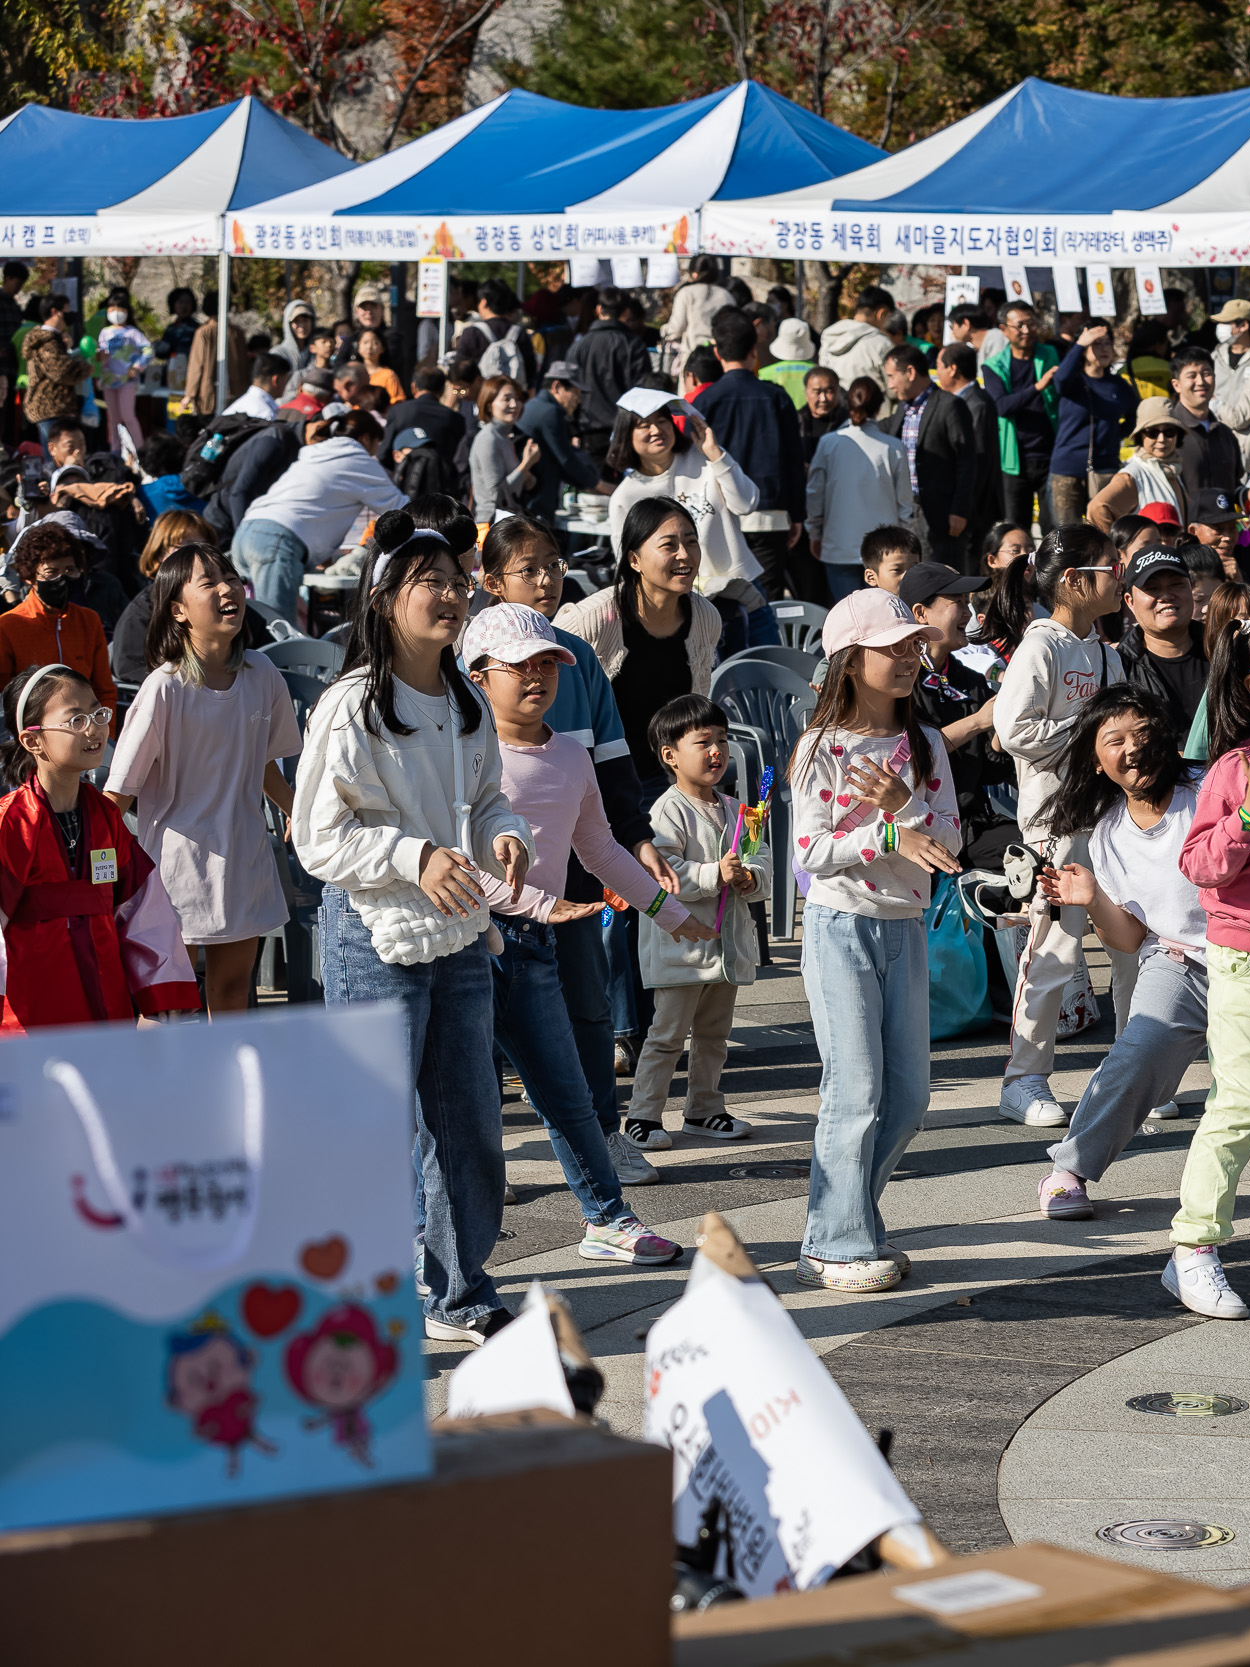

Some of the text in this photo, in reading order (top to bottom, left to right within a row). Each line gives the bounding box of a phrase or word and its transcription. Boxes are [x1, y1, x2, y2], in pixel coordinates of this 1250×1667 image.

[475, 224, 521, 251] 광장동
[530, 224, 579, 252] 상인회
[776, 221, 824, 250] 광장동
[831, 222, 882, 252] 체육회
[895, 224, 1058, 256] 새마을지도자협의회
[1135, 551, 1181, 573] Titleist
